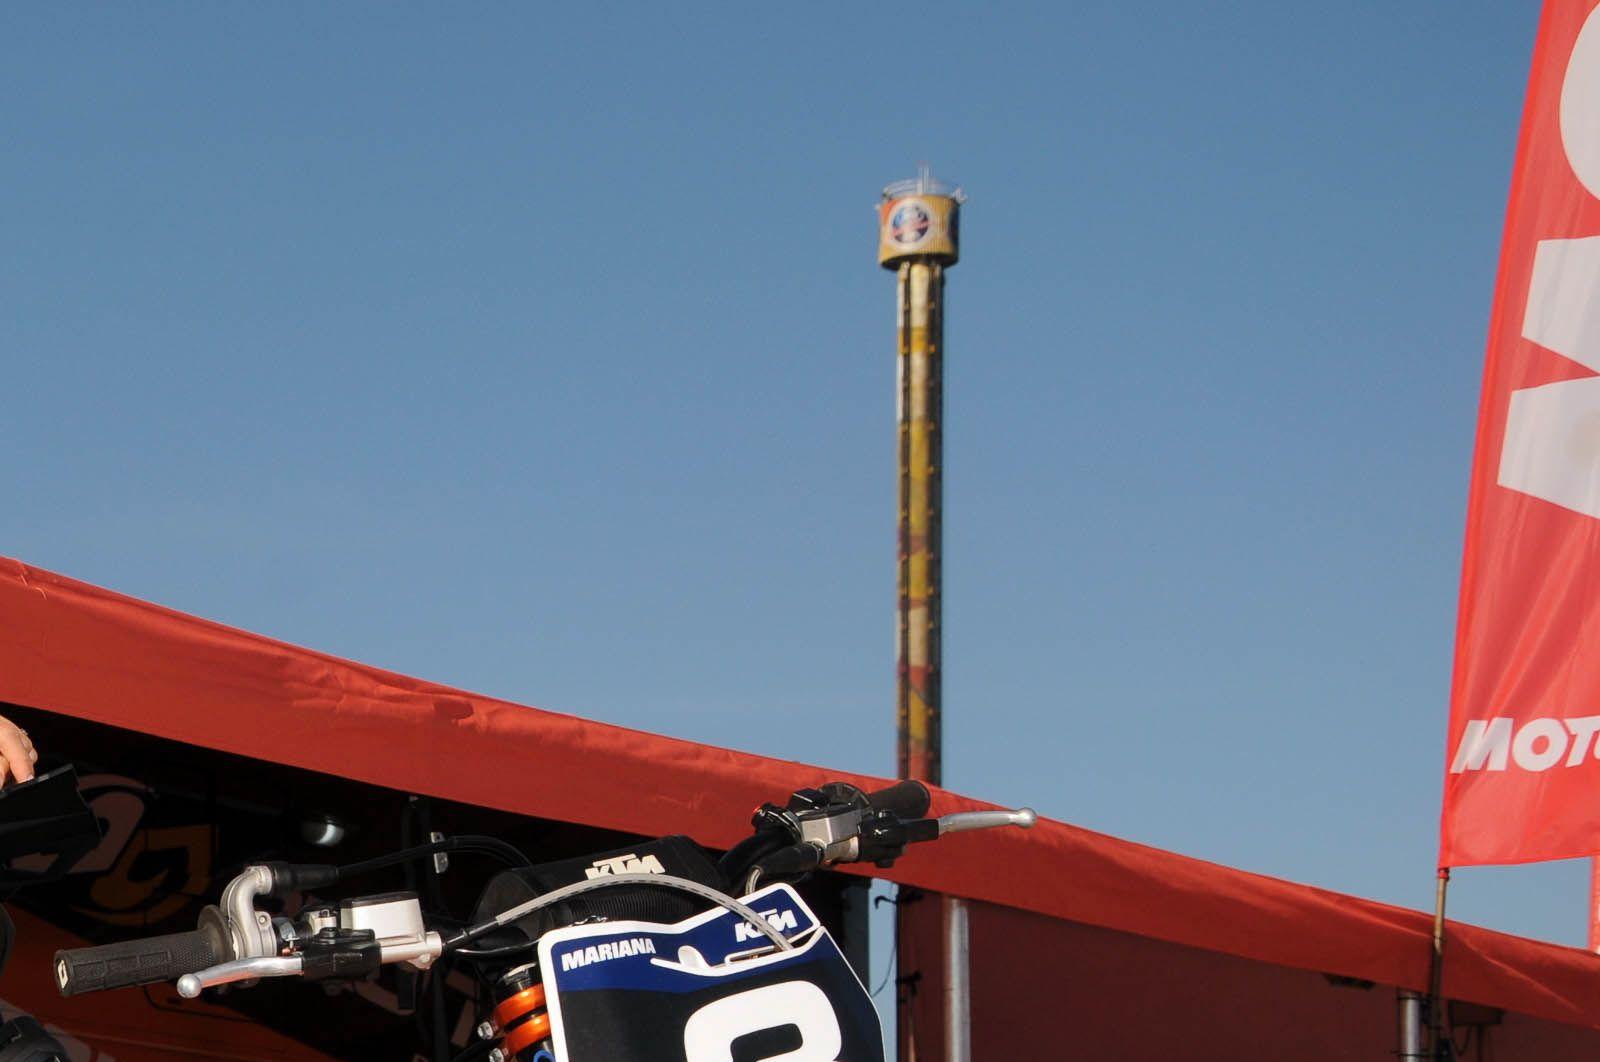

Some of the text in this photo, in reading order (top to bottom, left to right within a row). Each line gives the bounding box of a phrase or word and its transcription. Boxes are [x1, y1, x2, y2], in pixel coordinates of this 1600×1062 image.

[1450, 715, 1600, 774] MOT
[585, 853, 666, 880] KTM
[561, 938, 657, 972] MARIANA
